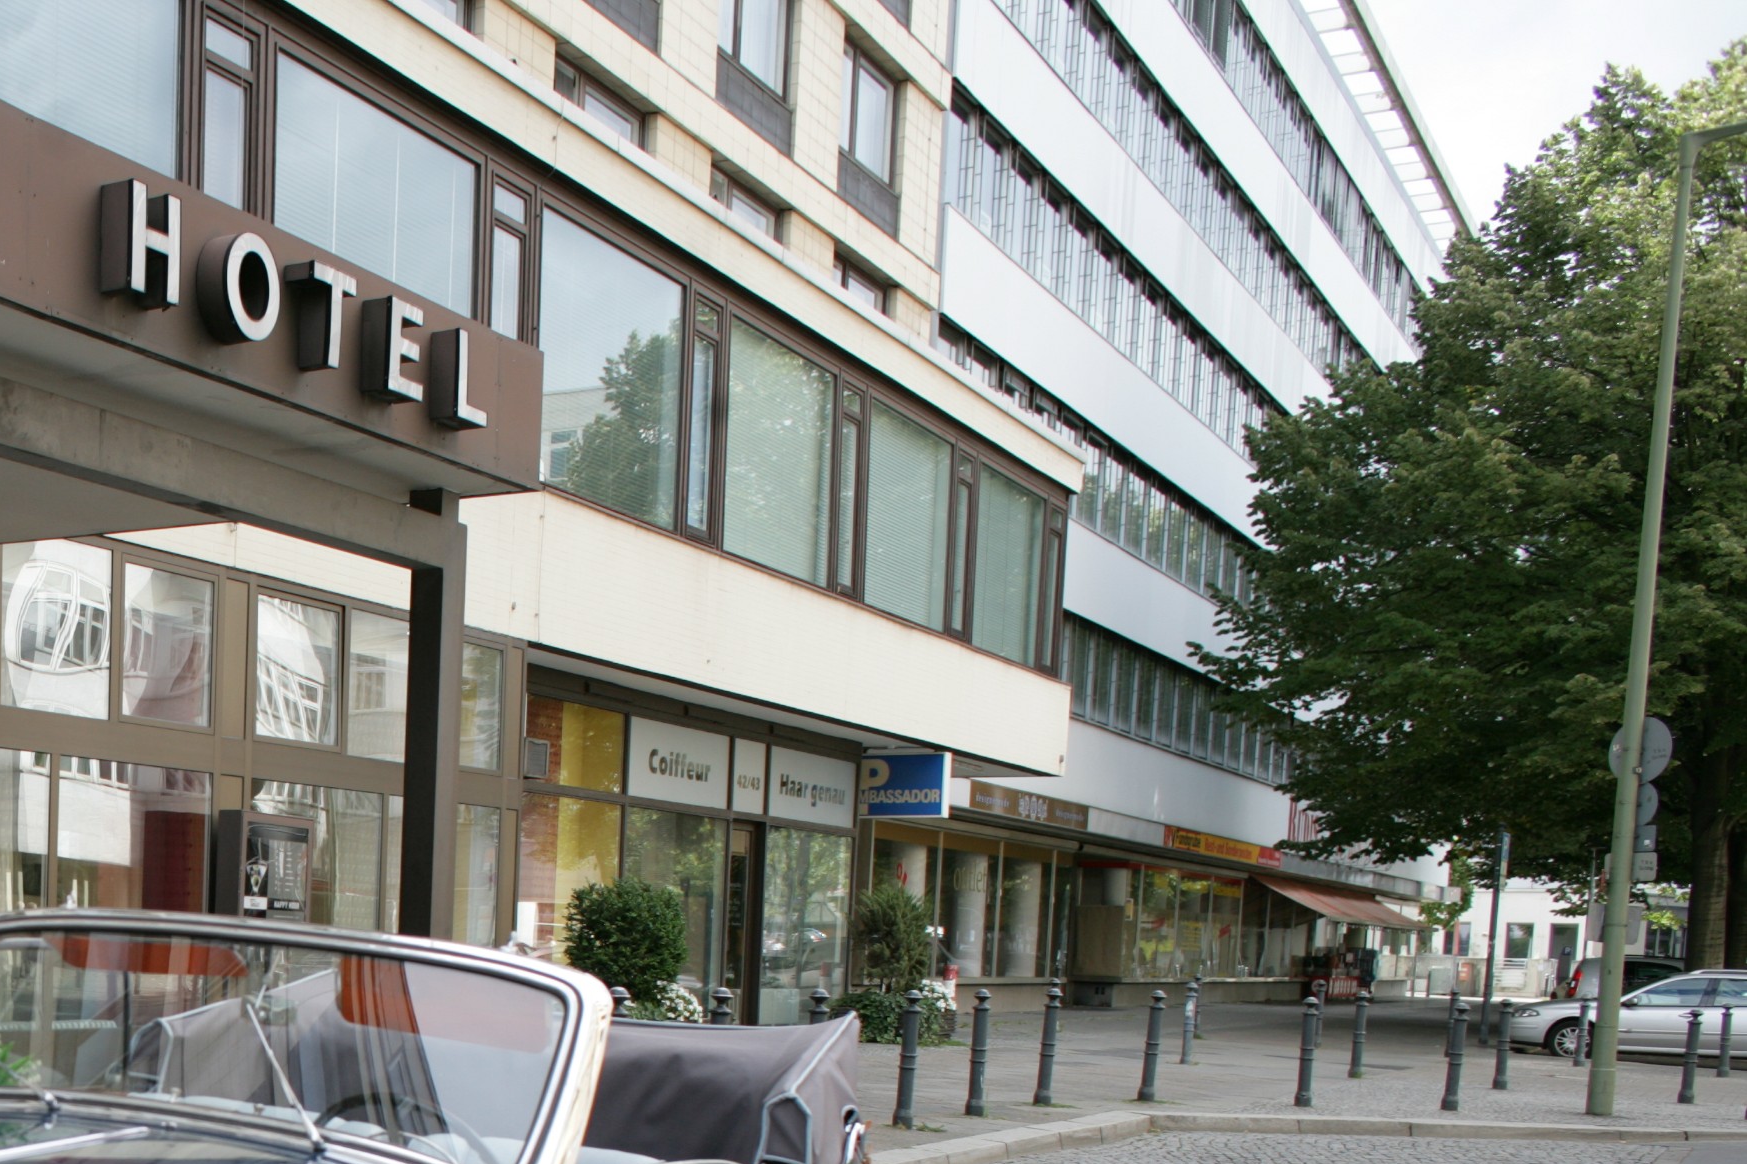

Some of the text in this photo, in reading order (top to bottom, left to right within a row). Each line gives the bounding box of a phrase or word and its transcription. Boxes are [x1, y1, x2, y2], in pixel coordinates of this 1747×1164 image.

[125, 178, 489, 430] HOTEL
[647, 748, 711, 783] Coiffeur
[736, 773, 761, 791] 42/43
[778, 772, 846, 808] Haar genau
[859, 788, 941, 804] MBASSADOR
